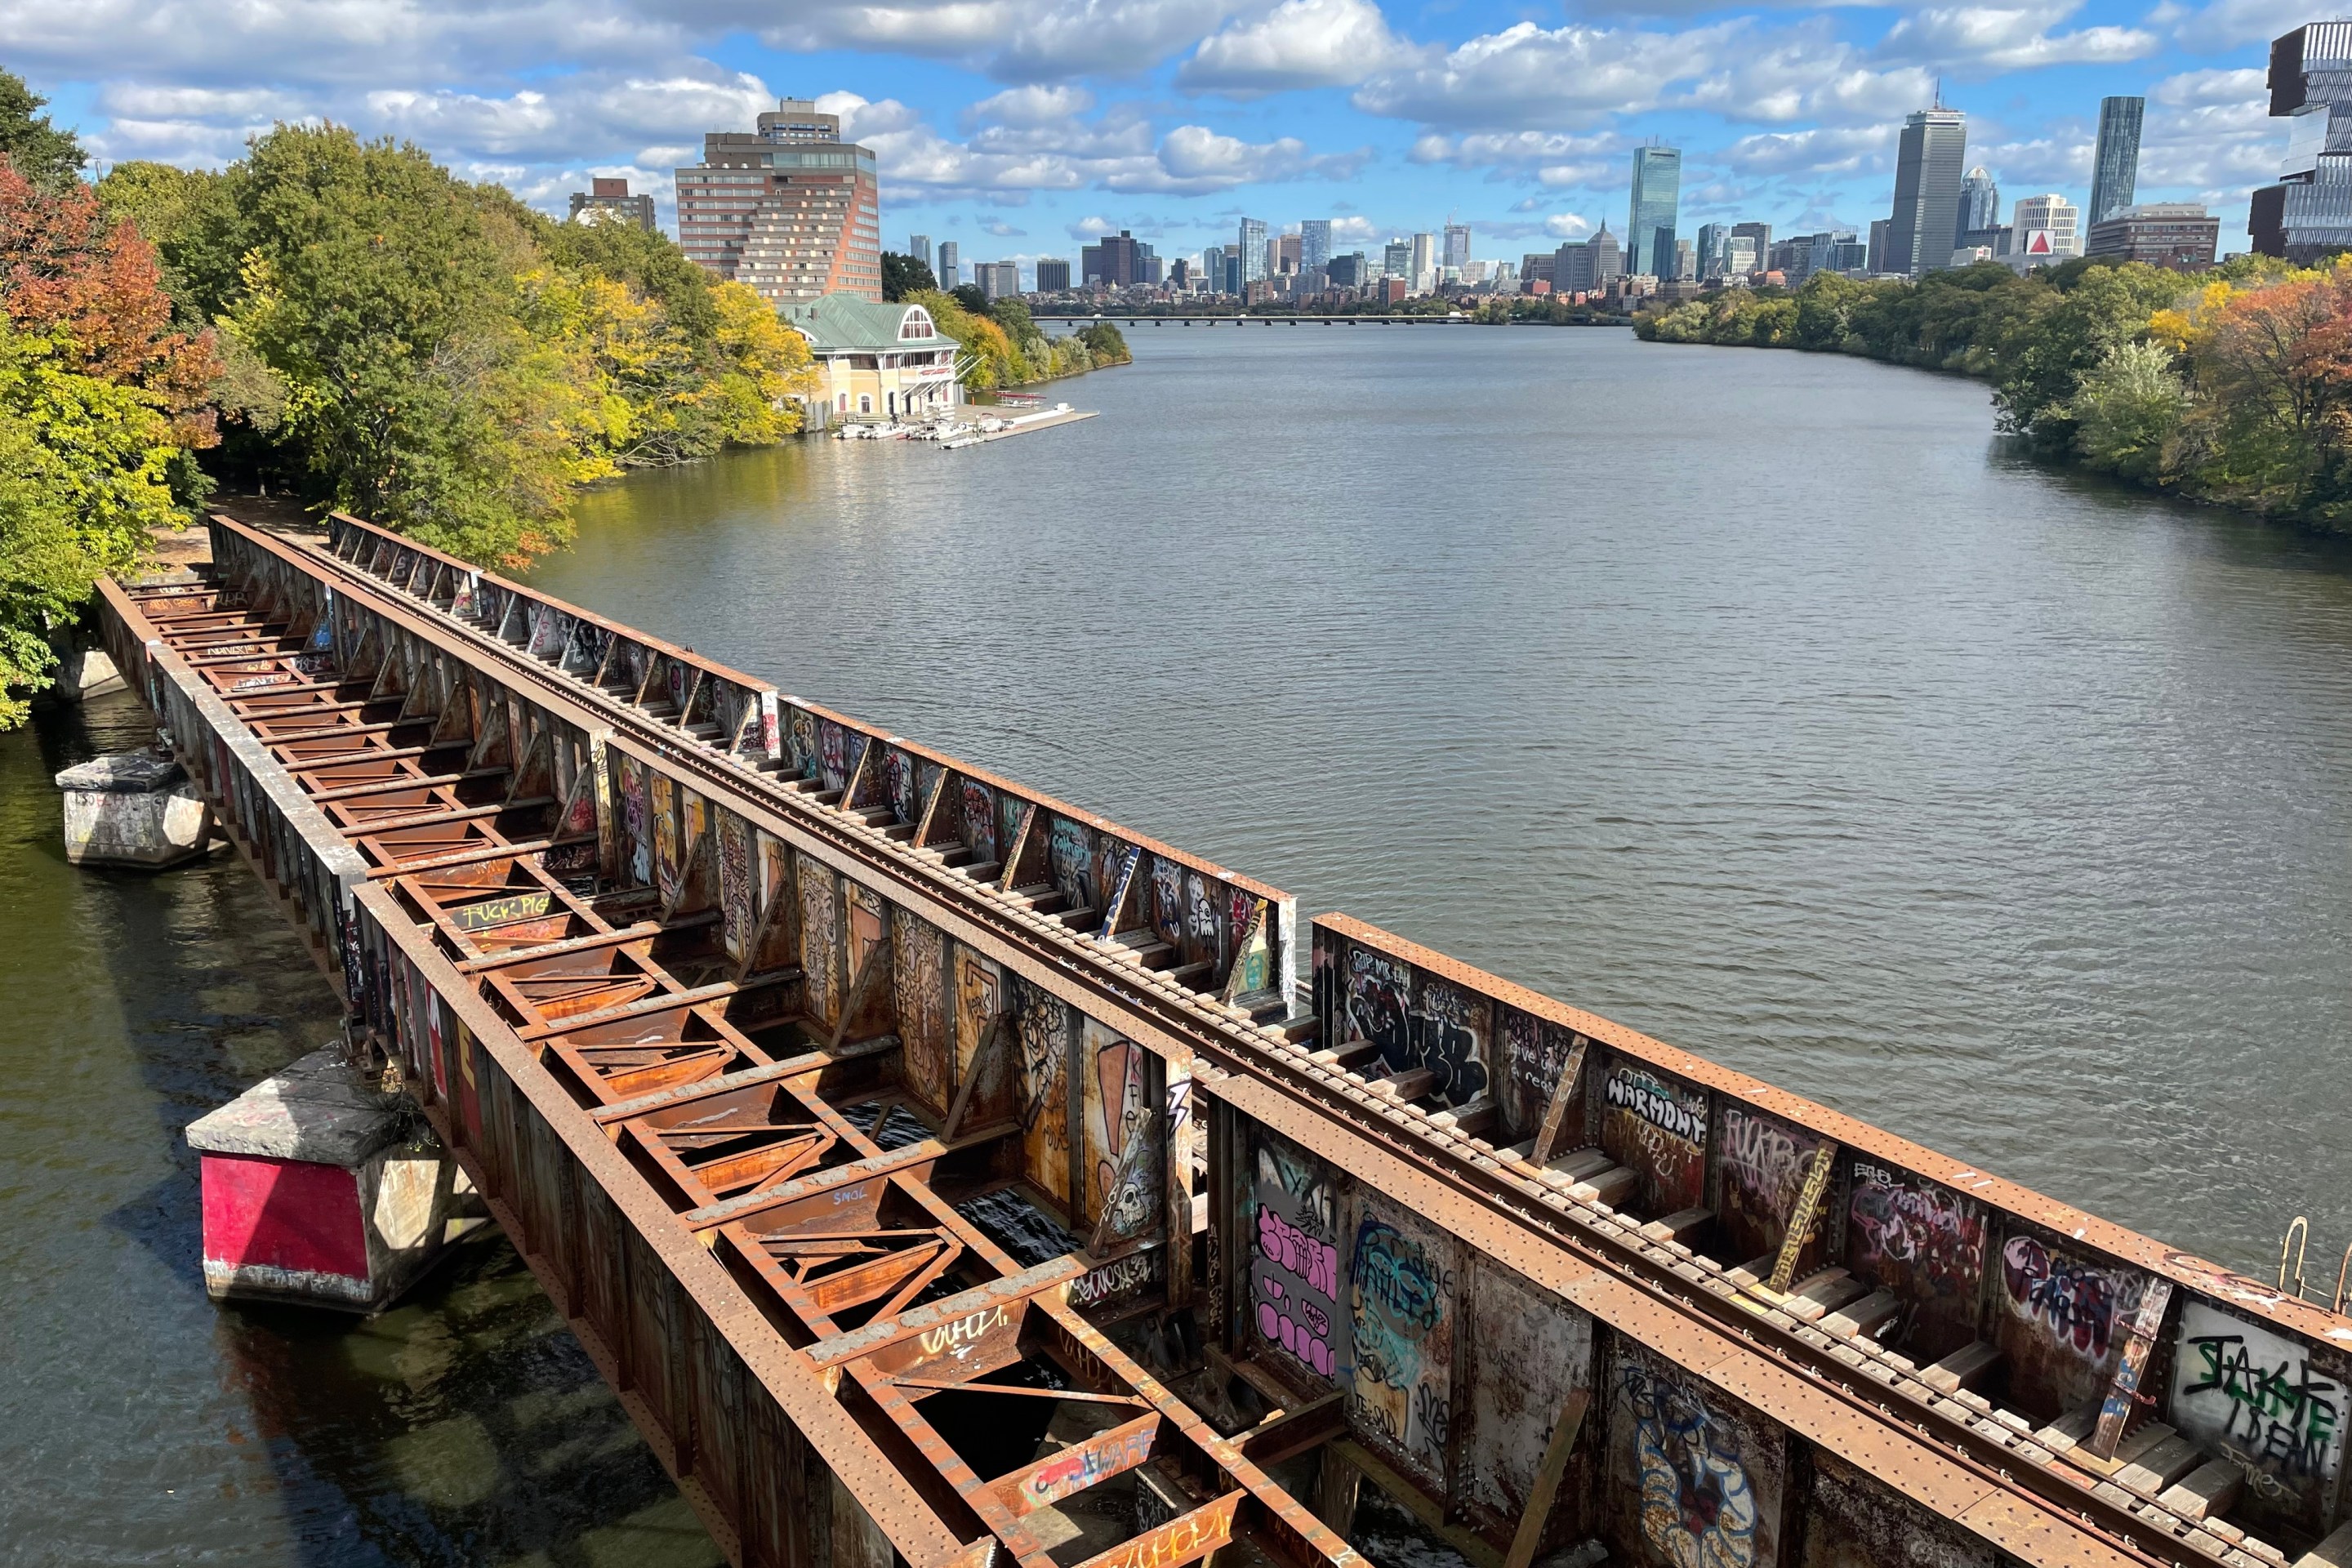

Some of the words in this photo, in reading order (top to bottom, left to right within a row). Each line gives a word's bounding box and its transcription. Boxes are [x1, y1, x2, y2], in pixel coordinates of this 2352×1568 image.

[463, 902, 520, 927] FUCK
[521, 896, 550, 914] PIG
[833, 1186, 868, 1205] SMOL
